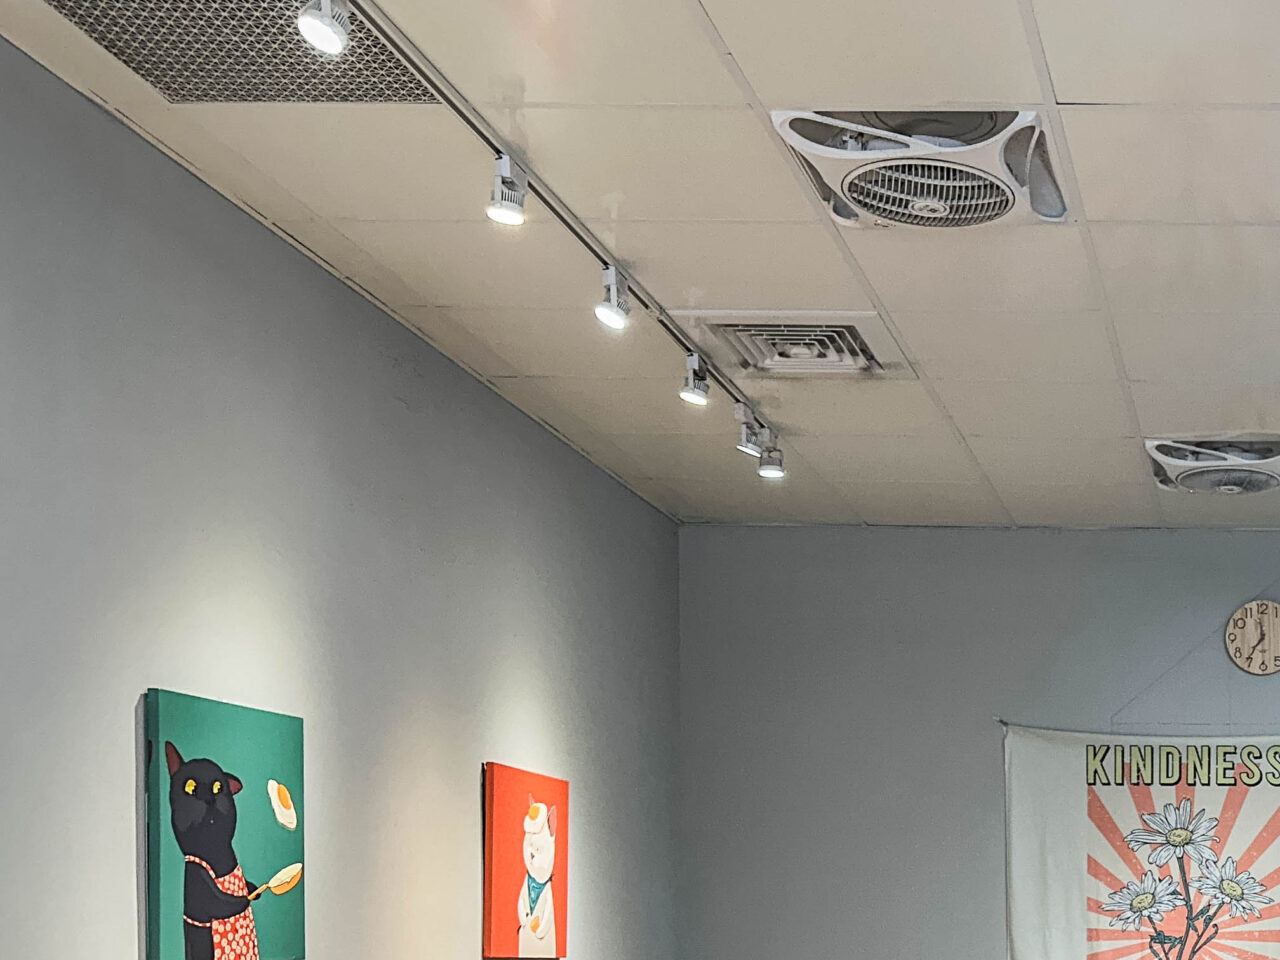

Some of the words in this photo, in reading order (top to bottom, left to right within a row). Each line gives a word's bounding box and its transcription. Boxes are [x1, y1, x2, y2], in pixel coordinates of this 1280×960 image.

[1244, 607, 1253, 619] 11
[1256, 602, 1269, 615] 12
[1232, 617, 1246, 630] 10
[1227, 632, 1237, 644] 9
[1234, 646, 1243, 659] 8
[1258, 660, 1268, 672] 6
